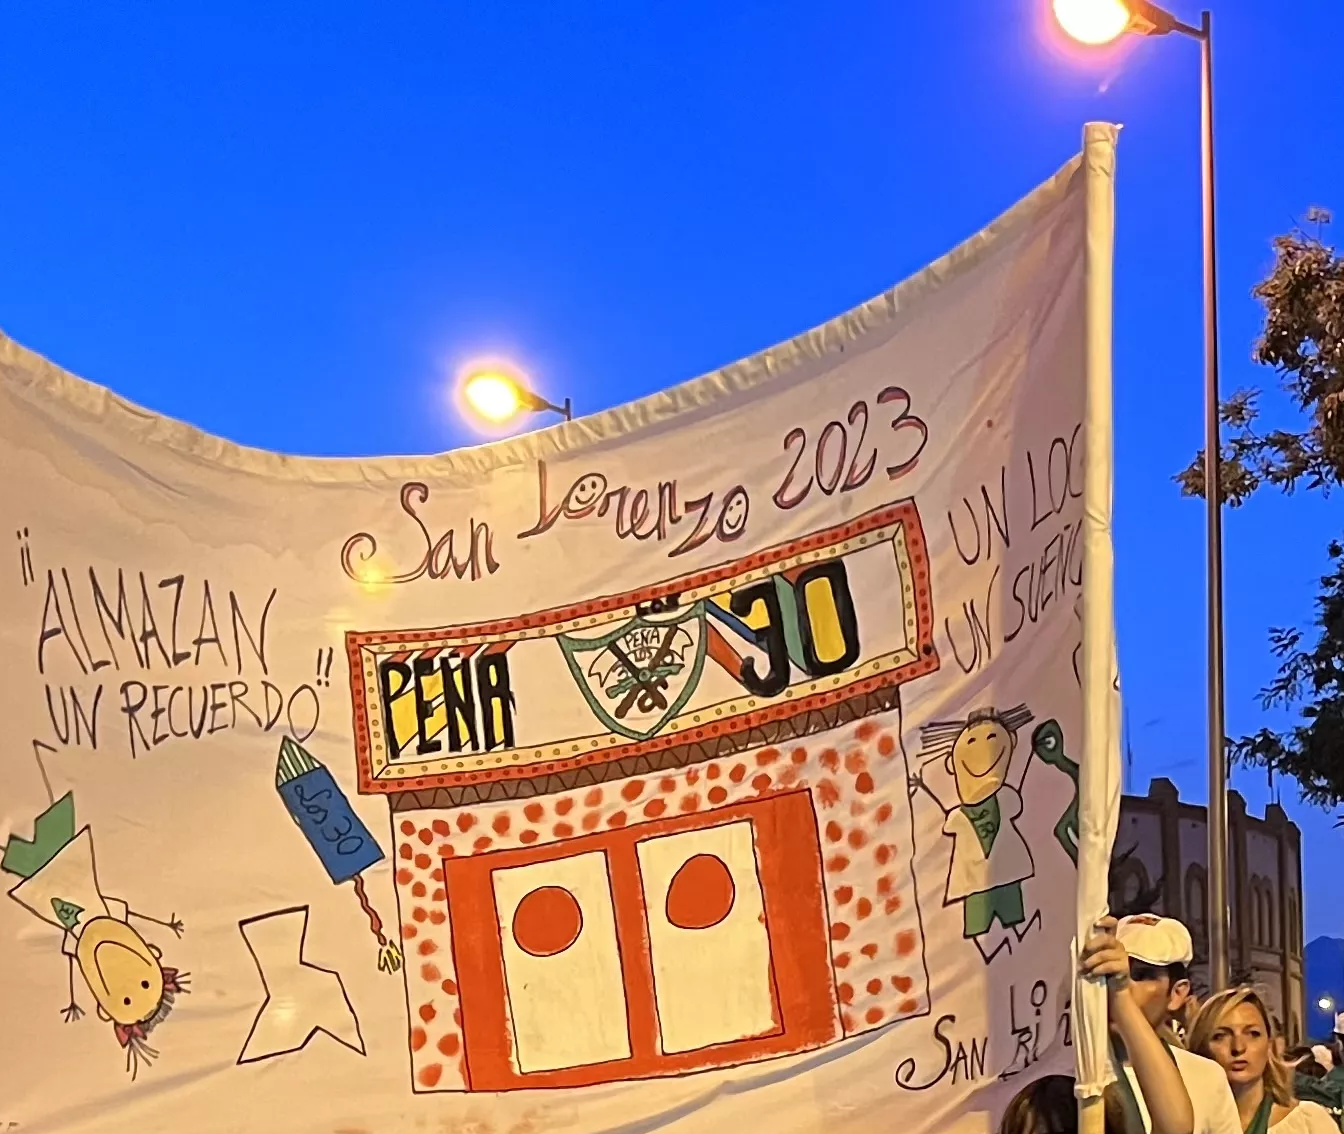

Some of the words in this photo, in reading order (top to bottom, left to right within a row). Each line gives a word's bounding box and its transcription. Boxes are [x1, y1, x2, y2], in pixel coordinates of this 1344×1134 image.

[341, 481, 499, 583] San
[518, 459, 750, 558] Lorenzo
[772, 386, 929, 509] 2023
[948, 465, 1010, 566] UN
[378, 640, 516, 760] PEÑA
[729, 556, 862, 698] 30
[945, 564, 1000, 674] UN
[45, 682, 102, 750] UN
[321, 815, 364, 856] 30
[895, 1014, 989, 1091] SAN
